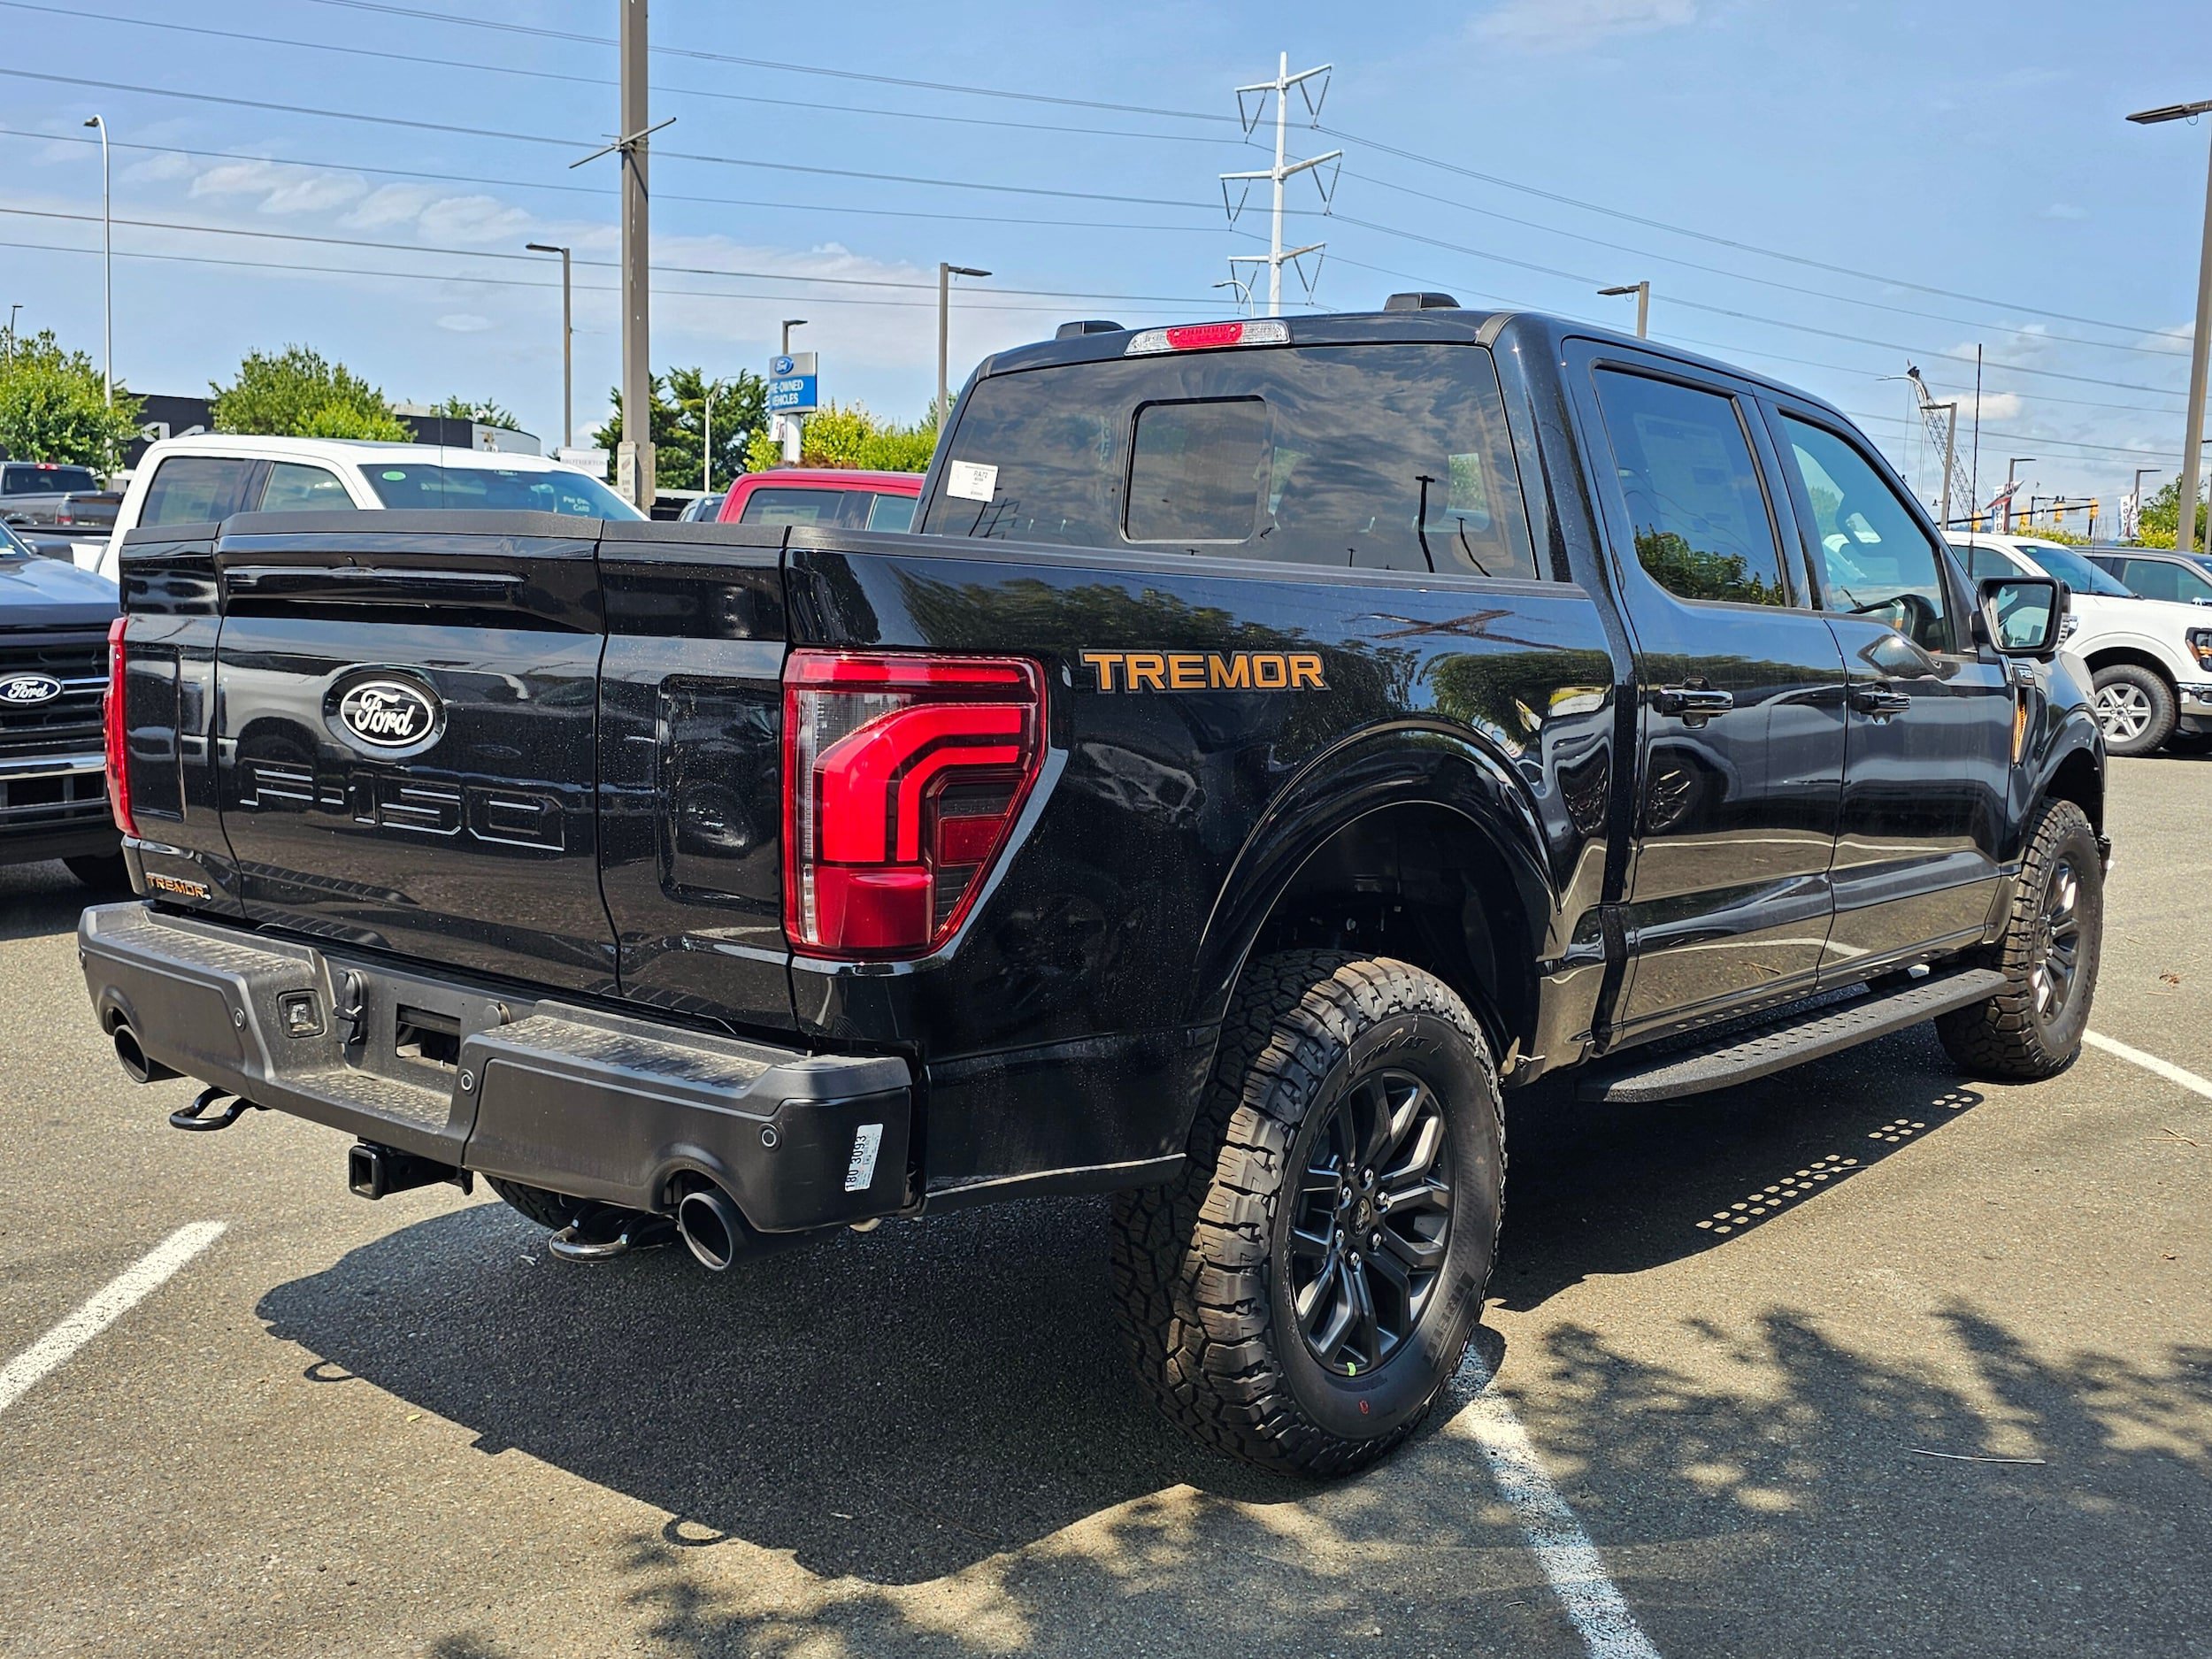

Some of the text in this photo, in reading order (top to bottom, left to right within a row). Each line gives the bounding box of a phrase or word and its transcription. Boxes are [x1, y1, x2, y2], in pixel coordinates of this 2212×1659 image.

[772, 393, 799, 407] EHICLES
[7, 680, 49, 699] Ford
[1081, 650, 1328, 692] TREMOR
[354, 689, 416, 736] Ford
[239, 757, 565, 852] F-150
[145, 873, 208, 899] TREMOR
[846, 1135, 867, 1188] 180 3093
